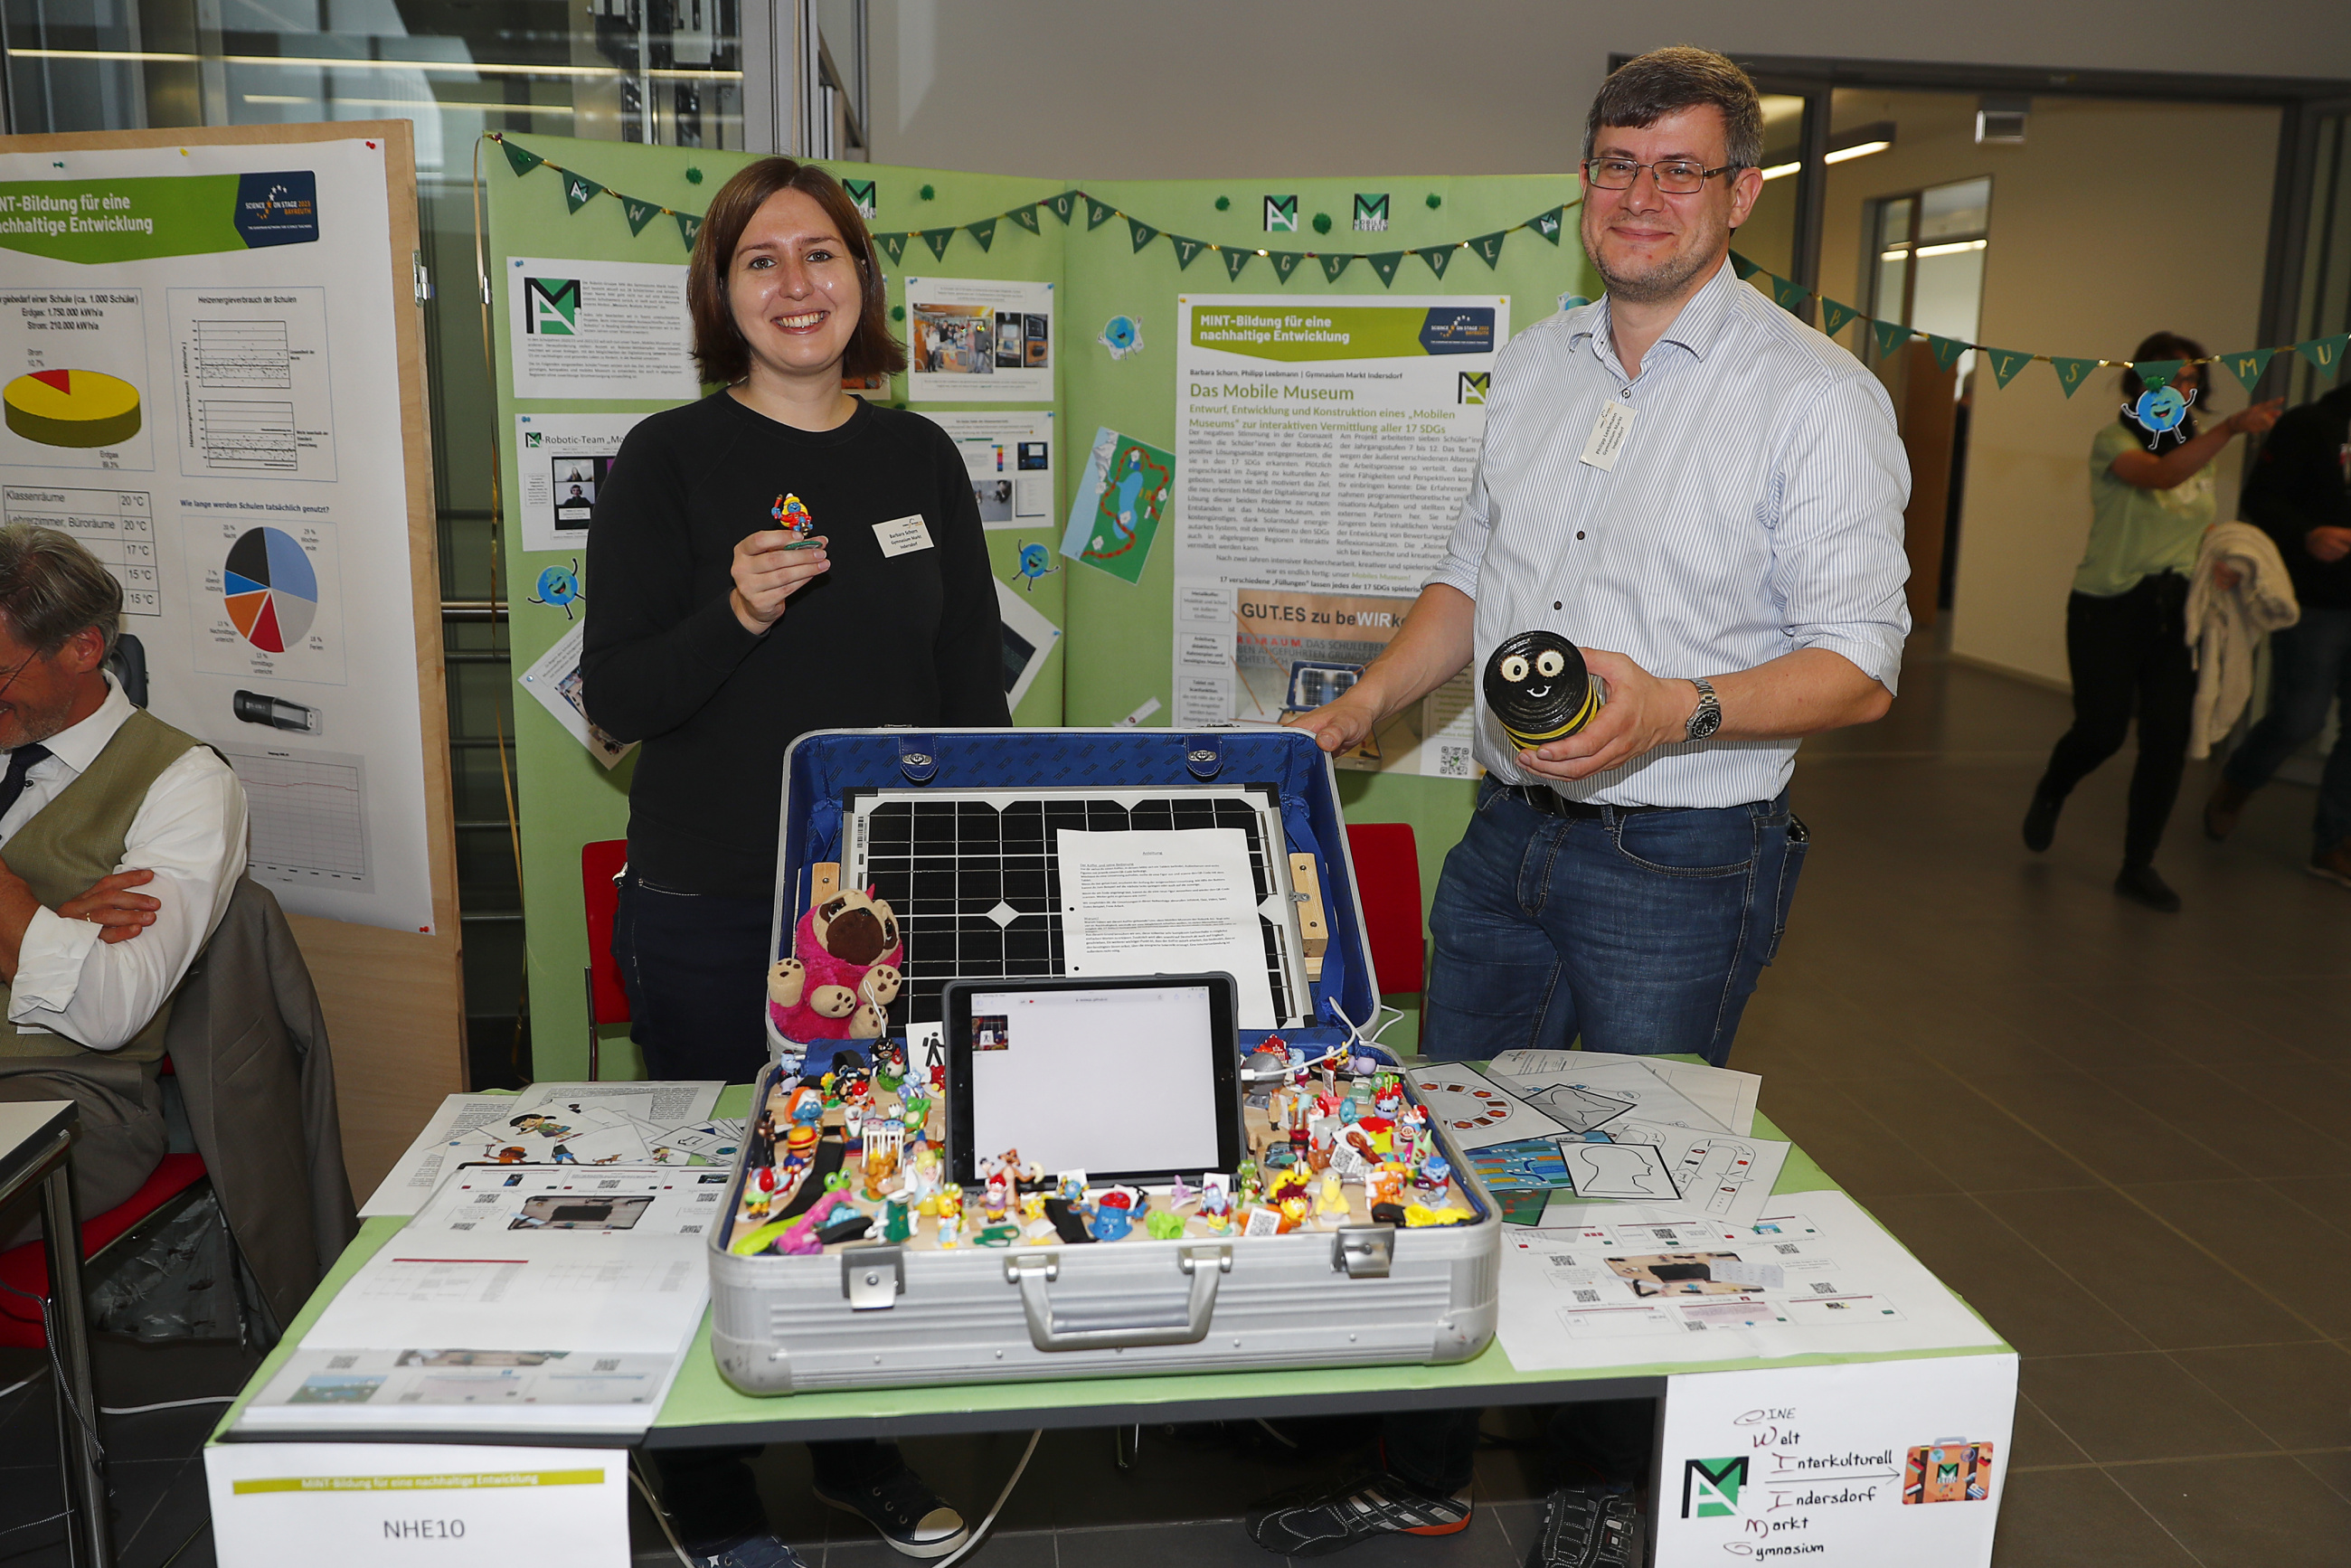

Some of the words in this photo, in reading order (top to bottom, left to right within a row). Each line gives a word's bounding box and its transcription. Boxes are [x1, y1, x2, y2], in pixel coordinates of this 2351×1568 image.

[80, 194, 99, 211] für
[102, 193, 130, 209] eine
[70, 215, 153, 235] Entwicklung
[1201, 315, 1281, 329] MINT-Bildung
[1285, 316, 1303, 327] für
[1306, 316, 1331, 327] eine
[1201, 329, 1270, 344] nachhaltige
[1274, 330, 1349, 345] Entwicklung
[1190, 383, 1218, 397] Das
[1224, 384, 1279, 399] Mobile
[1284, 385, 1354, 400] Museum
[1190, 404, 1229, 414] Entwurf,
[1232, 405, 1289, 416] Entwicklung
[1292, 407, 1310, 415] und
[1313, 407, 1376, 417] Konstruktion
[1380, 410, 1405, 418] eines
[1260, 420, 1317, 430] interaktiven
[1320, 422, 1377, 433] Vermittlung
[1381, 423, 1402, 432] aller
[1421, 425, 1446, 433] SDGs
[607, 436, 624, 444] „Mo
[1355, 443, 1405, 451] Jahrgangsstufen
[6, 490, 65, 502] Klassenräume
[121, 496, 131, 505] 20
[1275, 489, 1318, 497] Digitalisierung
[266, 504, 300, 512] tatsächlich
[69, 517, 115, 529] Büroräume
[125, 521, 134, 530] 20
[127, 545, 136, 554] 17
[128, 570, 137, 580] 15
[131, 594, 140, 603] 15
[1241, 603, 1306, 622] GUT.ES
[1312, 612, 1330, 623] zu
[1307, 640, 1325, 648] DAS
[1753, 1426, 1800, 1448] Welt
[1770, 1450, 1893, 1473] Interkulturell
[302, 1478, 372, 1489] MINT-Bildung
[374, 1477, 389, 1487] für
[391, 1477, 412, 1487] eine
[416, 1476, 474, 1488] nachhaltige
[477, 1474, 538, 1485] Entwicklung
[1767, 1487, 1876, 1512] Indersdorf
[384, 1519, 465, 1538] NHE10
[1745, 1517, 1808, 1538] Markt
[1723, 1542, 1824, 1561] Gymnasium
